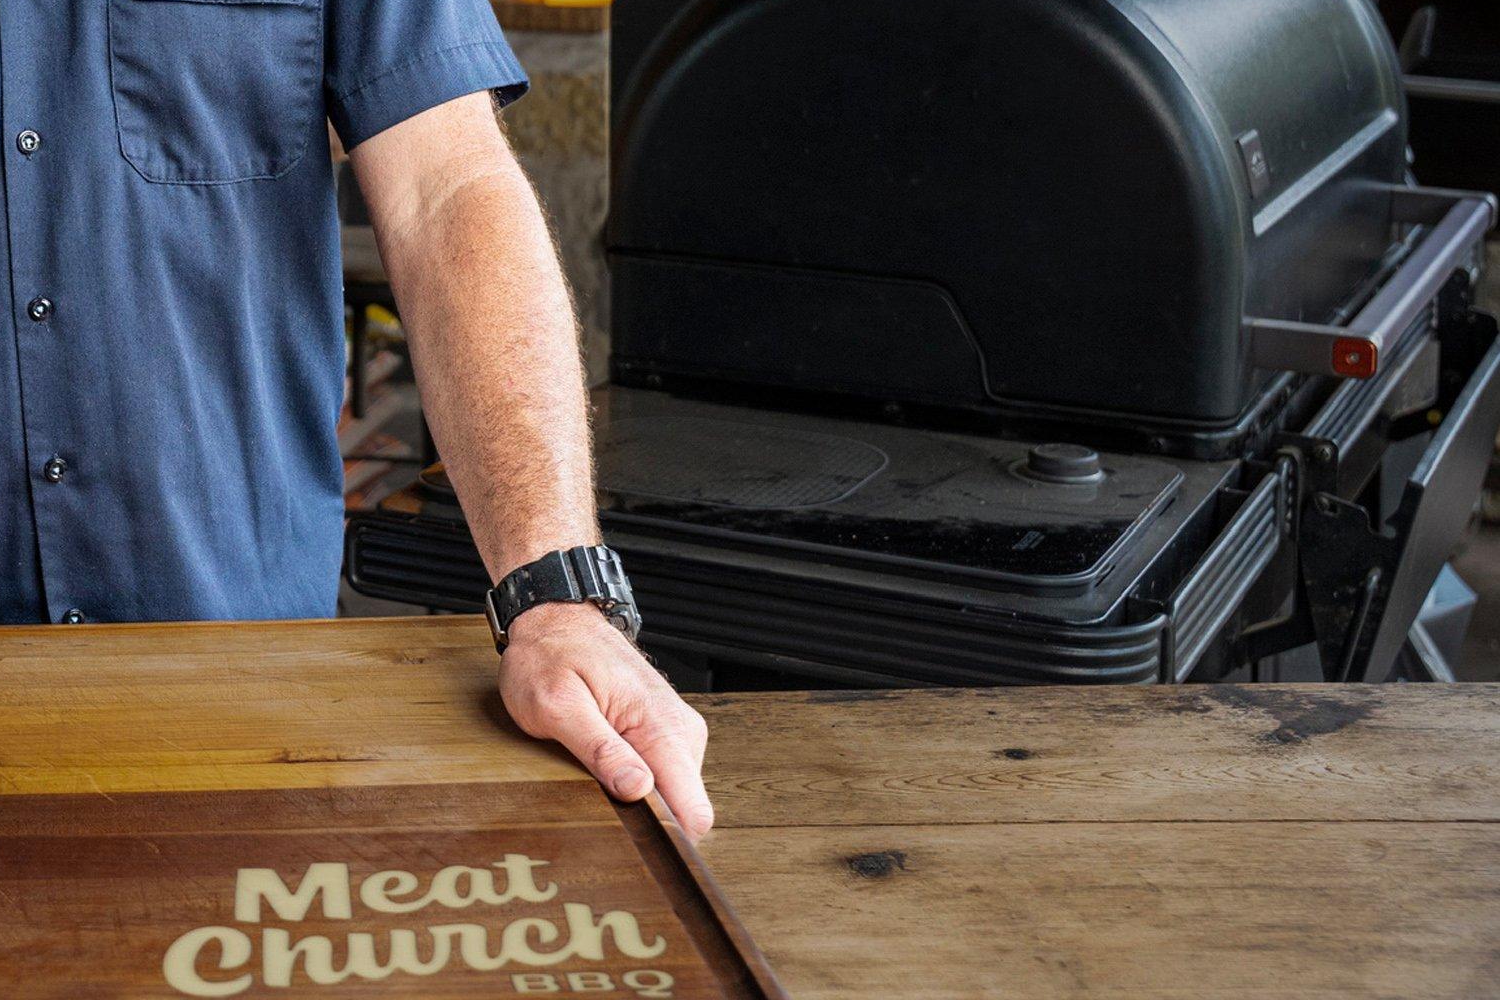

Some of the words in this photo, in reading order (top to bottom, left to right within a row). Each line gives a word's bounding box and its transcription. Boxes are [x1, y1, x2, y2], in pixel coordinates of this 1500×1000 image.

[234, 853, 559, 923] Meat
[163, 903, 667, 997] Church
[511, 970, 674, 997] BBQ
